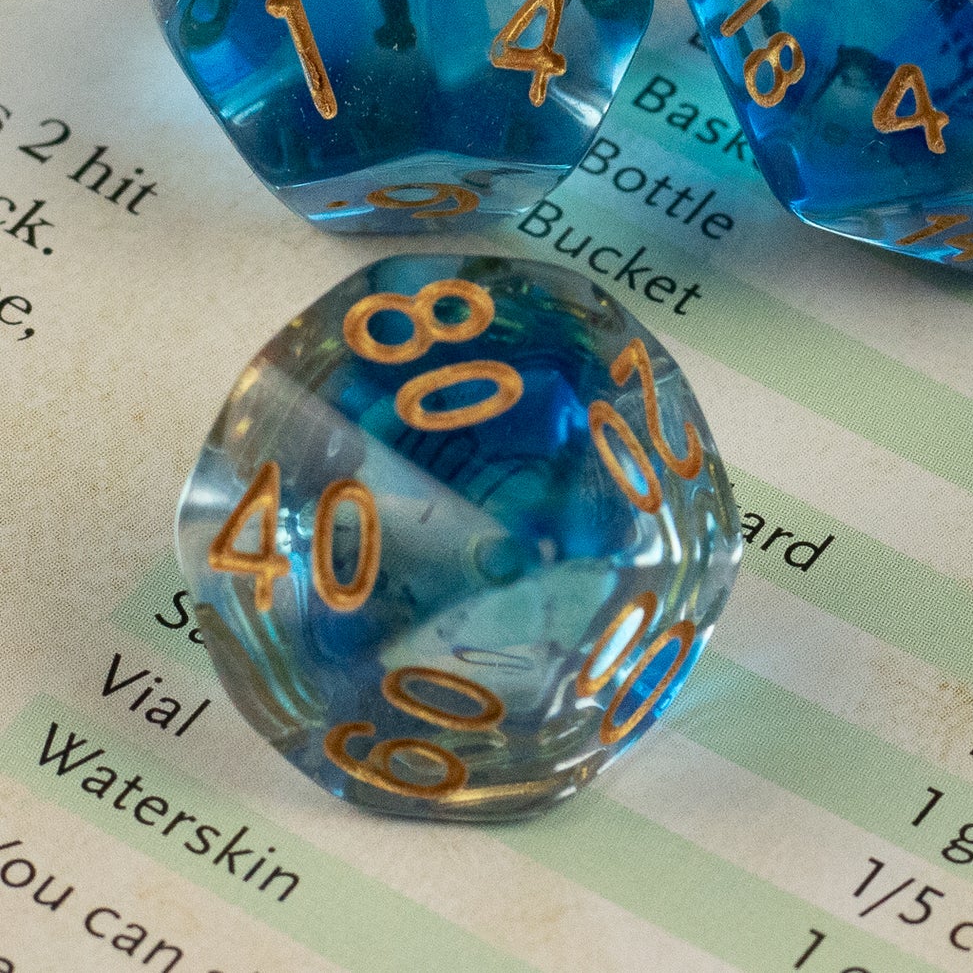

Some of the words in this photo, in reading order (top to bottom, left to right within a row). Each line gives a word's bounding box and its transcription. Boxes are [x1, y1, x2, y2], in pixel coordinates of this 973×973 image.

[632, 74, 760, 170] Bask
[872, 63, 950, 155] 4
[18, 117, 72, 165] 2
[65, 144, 158, 217] hit
[580, 135, 738, 241] Bottle
[517, 201, 706, 319] Bucket
[208, 460, 381, 612] 40
[102, 653, 211, 737] Vial
[38, 721, 301, 903] Waterskin
[911, 787, 944, 828] 1
[852, 857, 946, 925] 1/5
[84, 907, 184, 973] can
[793, 929, 827, 969] 1
